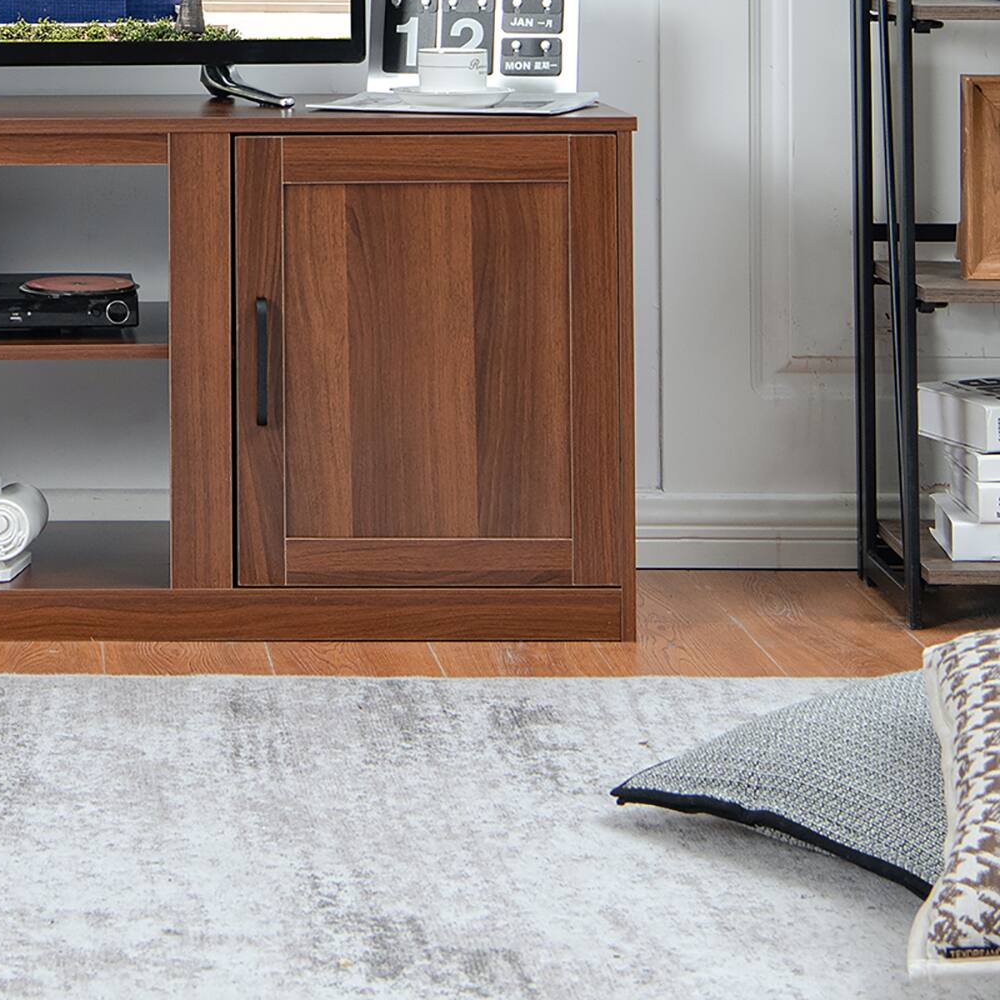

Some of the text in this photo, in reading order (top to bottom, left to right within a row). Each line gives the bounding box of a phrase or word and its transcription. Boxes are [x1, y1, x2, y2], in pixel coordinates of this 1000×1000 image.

[510, 17, 534, 27] JAN
[396, 16, 484, 66] 1 2
[505, 61, 531, 70] MON
